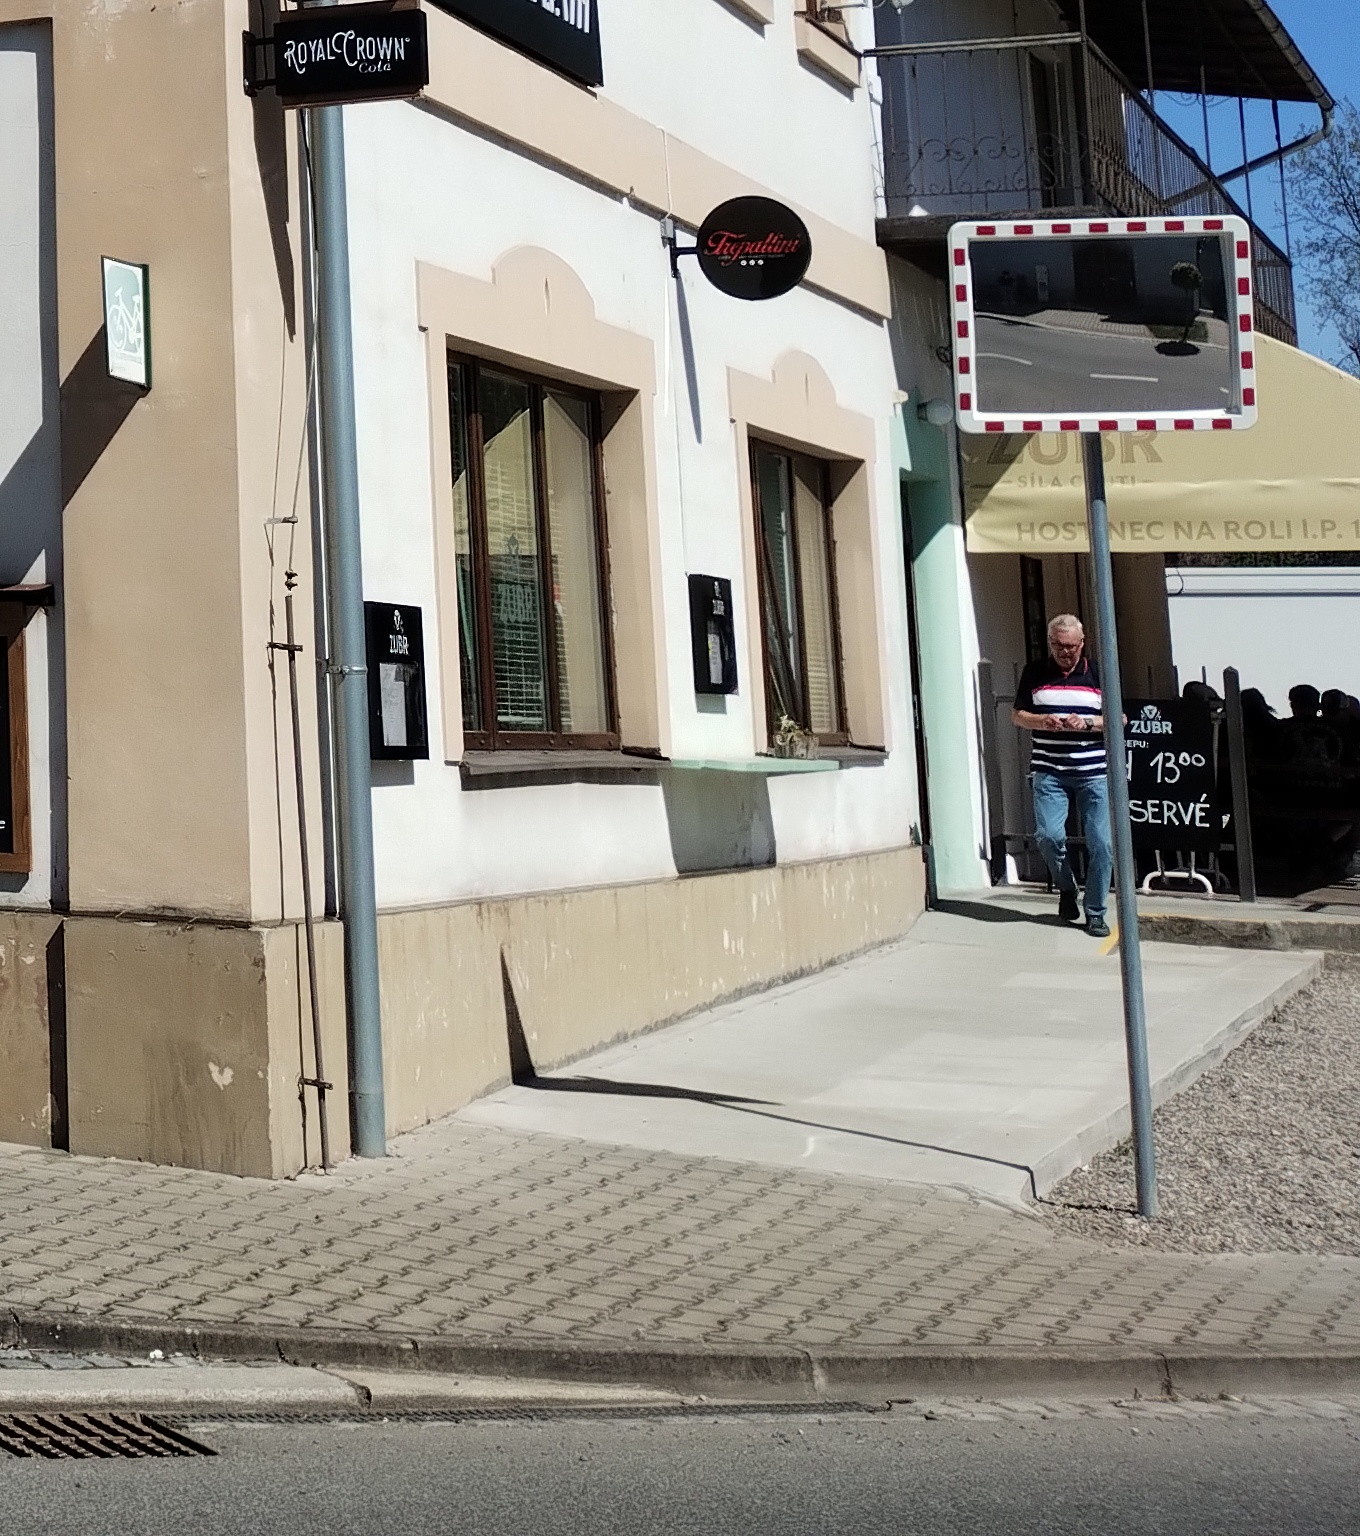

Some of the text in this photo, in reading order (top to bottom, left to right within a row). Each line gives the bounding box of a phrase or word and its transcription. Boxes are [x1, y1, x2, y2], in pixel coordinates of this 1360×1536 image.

[284, 30, 405, 74] ROYAL CROWN
[359, 61, 391, 73] Cola
[1017, 520, 1166, 542] HOSTNEC
[1174, 520, 1215, 540] NA
[1223, 520, 1292, 540] ROLI
[1130, 720, 1172, 734] ZUBR
[1125, 739, 1149, 749] EPU:
[1128, 793, 1210, 827] SERVÉ
